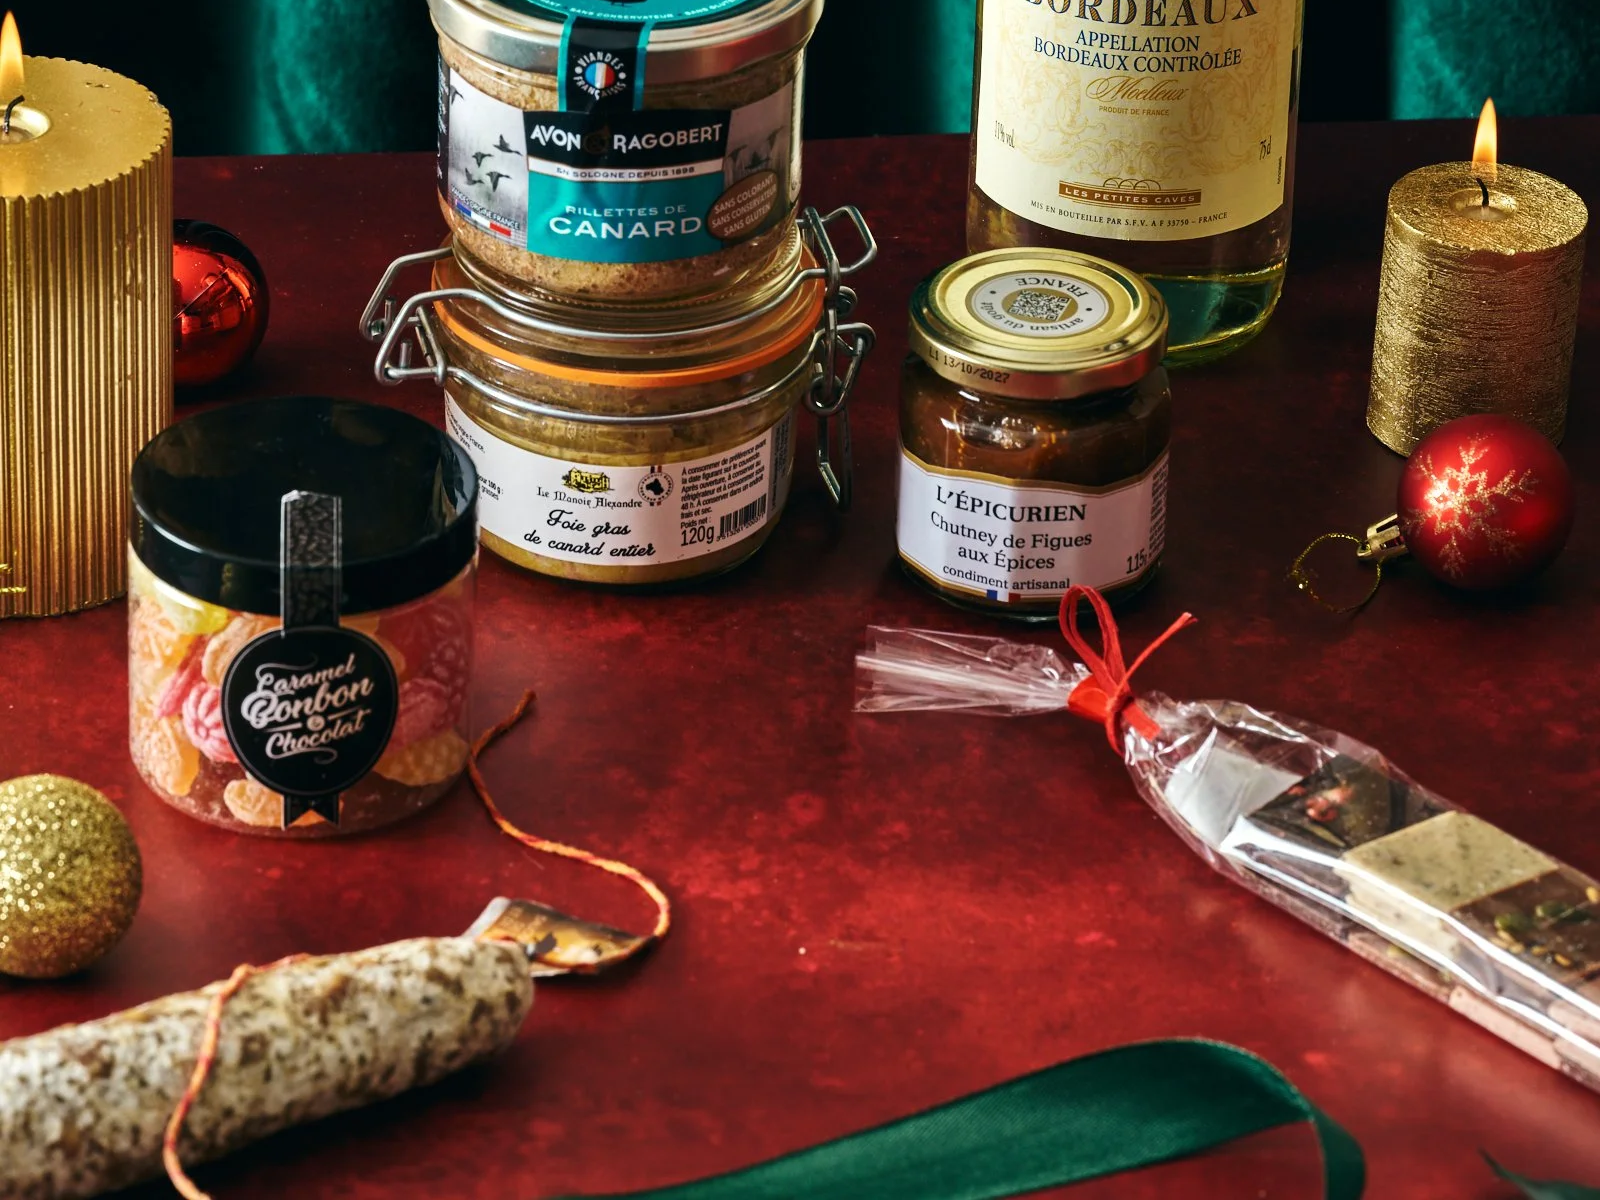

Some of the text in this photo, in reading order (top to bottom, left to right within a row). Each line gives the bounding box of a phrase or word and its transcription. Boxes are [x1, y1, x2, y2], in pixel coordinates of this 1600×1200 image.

[1075, 30, 1200, 52] APPELLATION
[578, 51, 624, 70] VIANDES
[1034, 36, 1242, 73] BORDEAUX CONTRÔLÉE
[1086, 76, 1190, 102] Moelleux
[1098, 106, 1128, 115] PRODUIT
[530, 124, 581, 152] AVON
[614, 124, 722, 154] RAGOBERT
[556, 166, 695, 179] EN SOLOGNE DEPUIS 1898
[714, 173, 774, 214] SANS COLORANT
[1065, 187, 1195, 204] LES PETITES CAVES
[492, 212, 520, 230] FRANCE
[565, 204, 688, 218] RILLETTES DE
[711, 212, 731, 228] SANS
[724, 202, 771, 236] SANS GLUTEN
[1030, 200, 1044, 210] MIS
[1046, 206, 1056, 214] EN
[1058, 208, 1104, 224] BOUTEILLE
[1106, 217, 1122, 225] PAR
[1198, 211, 1228, 224] FRANCE
[549, 216, 702, 240] CANARD
[1015, 277, 1089, 298] FRANCE
[1004, 320, 1024, 330] du
[1030, 317, 1084, 332] artisan
[929, 346, 1010, 384] L1 13/10/2027
[688, 461, 720, 474] consommer
[721, 458, 728, 466] de
[688, 474, 702, 484] date
[702, 468, 723, 480] figurant
[732, 462, 738, 470] le
[682, 484, 698, 494] Après
[732, 464, 754, 478] conserver
[537, 486, 550, 497] Le
[592, 497, 642, 509] Alexandre
[680, 502, 688, 510] 48
[702, 492, 729, 506] conserver
[730, 488, 742, 497] dans
[546, 509, 632, 538] Foie gras
[680, 510, 694, 519] frais
[680, 520, 698, 529] Poids
[698, 516, 708, 525] net
[680, 525, 714, 547] 120g
[931, 511, 1093, 550] Chutney de Figues
[524, 530, 656, 557] de canard entier
[958, 547, 1055, 572] aux Épices
[942, 564, 1070, 590] condiment artisanal
[255, 652, 356, 696] Caramel
[240, 678, 375, 730] Bonbon
[265, 708, 372, 760] Chocolat
